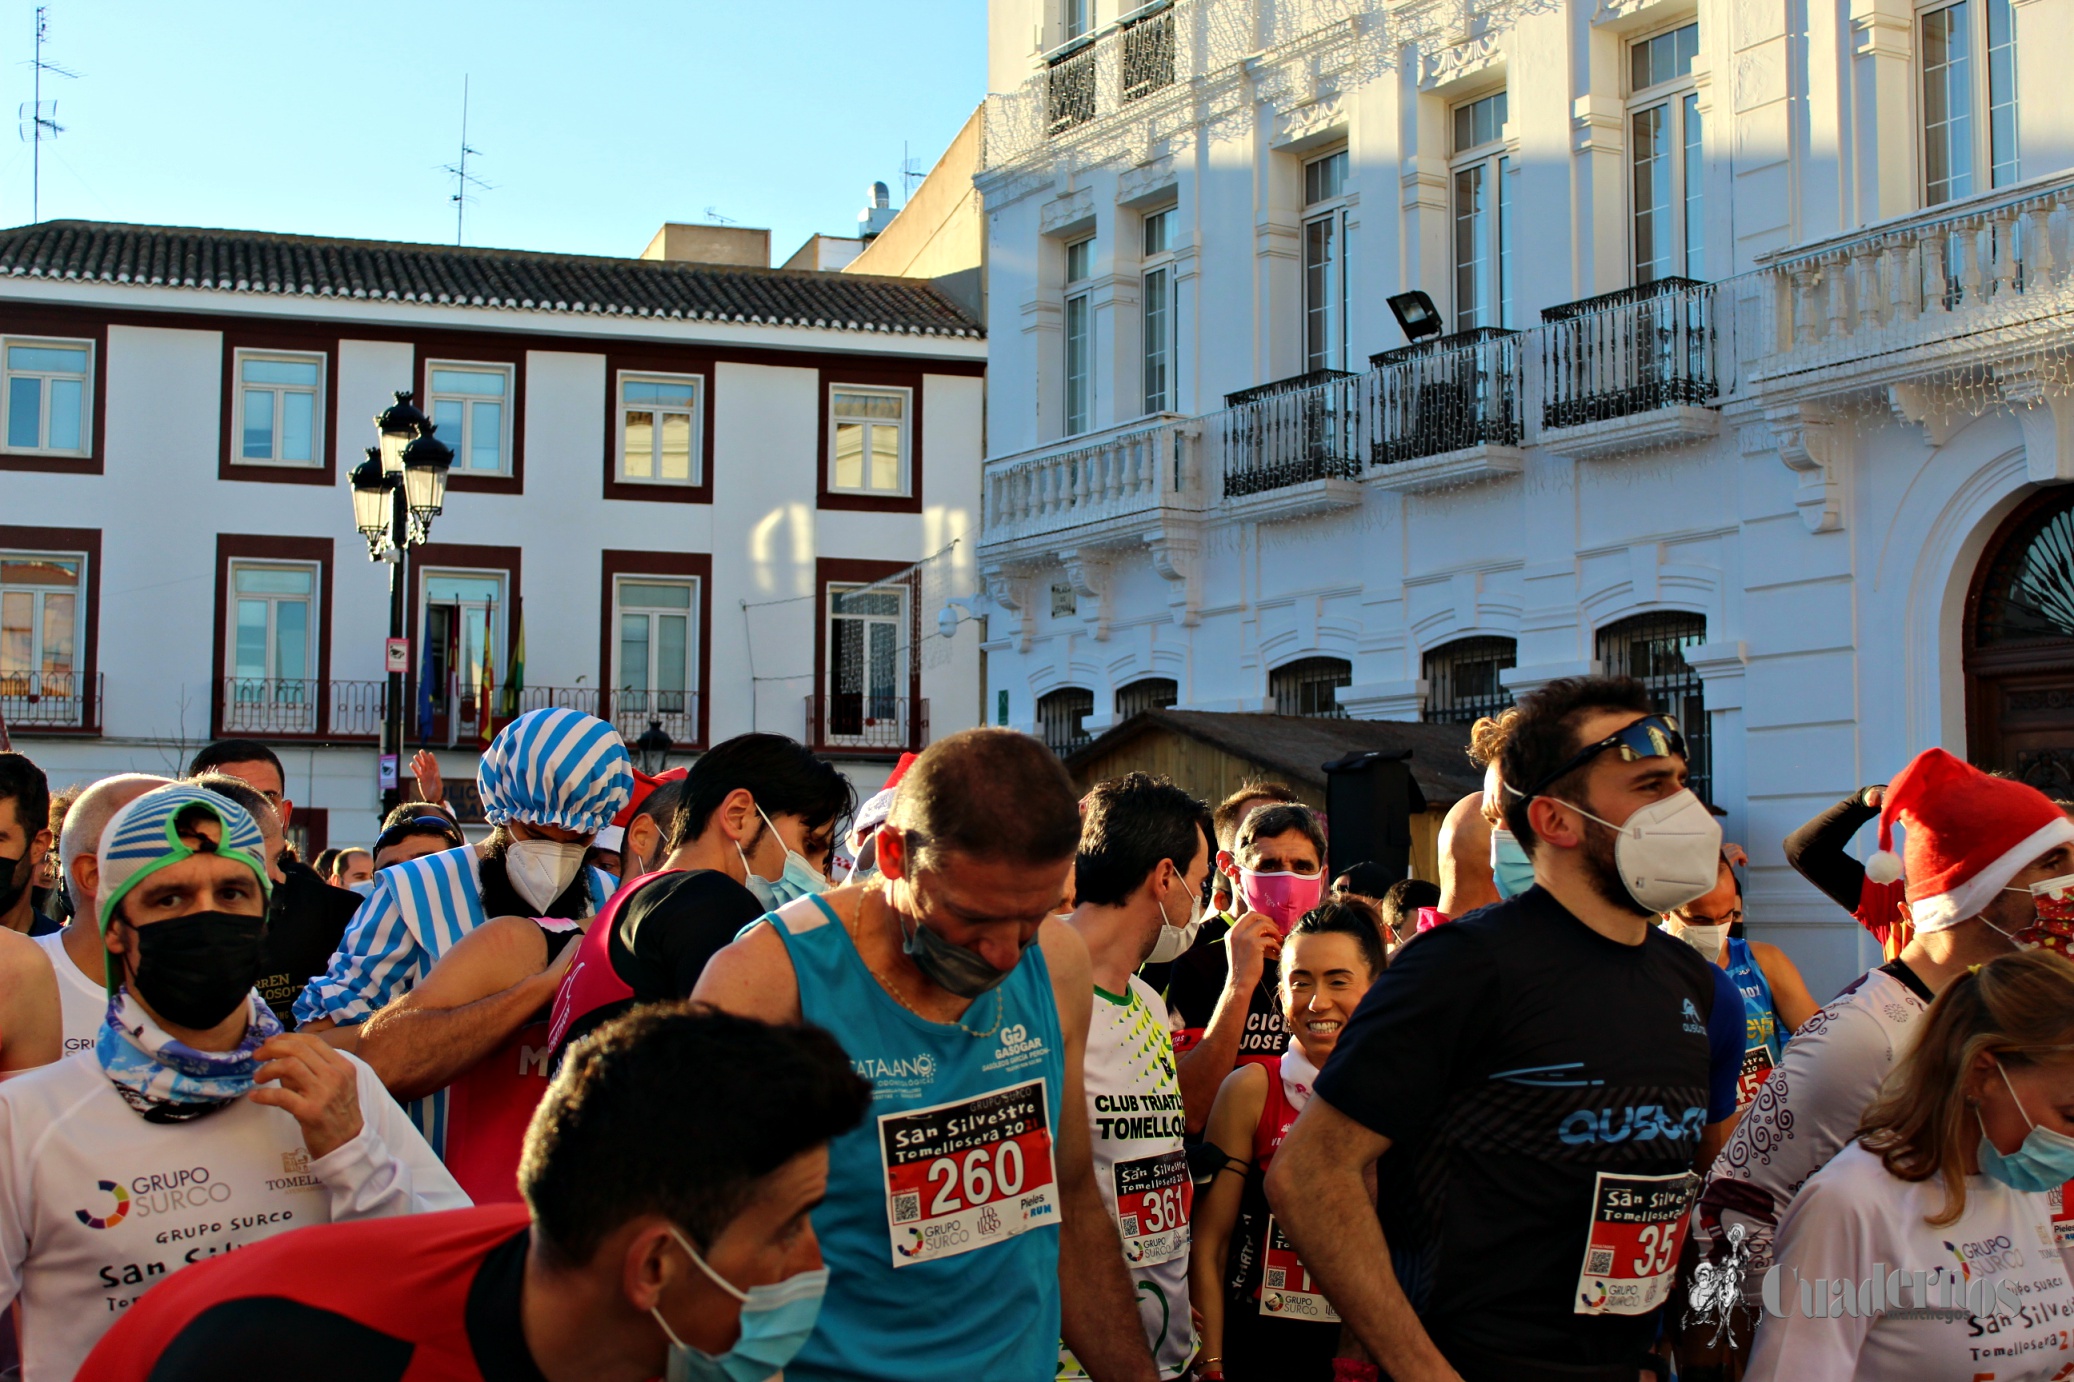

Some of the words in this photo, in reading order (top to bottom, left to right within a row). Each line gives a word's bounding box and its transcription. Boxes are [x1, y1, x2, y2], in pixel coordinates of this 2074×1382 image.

[995, 1037, 1042, 1059] GASOGAR
[970, 1095, 1001, 1112] GRUPO
[1001, 1086, 1032, 1103] SURCO
[1095, 1094, 1139, 1112] CLUB
[895, 1127, 938, 1148] San
[947, 1102, 1035, 1137] Silvestre
[895, 1129, 999, 1163] Tomellosera
[1005, 1117, 1038, 1136] 2021
[132, 1167, 209, 1194] GRUPO
[928, 1140, 1024, 1216] 260
[1122, 1168, 1148, 1183] San
[1153, 1160, 1186, 1177] Silvestre
[1121, 1176, 1177, 1195] Tomellosera
[136, 1182, 231, 1217] SURCO
[1021, 1193, 1044, 1210] Pieles
[1143, 1185, 1187, 1232] 361
[1607, 1191, 1642, 1207] San
[1030, 1204, 1052, 1218] RUN
[1604, 1208, 1681, 1222] Tomellosera
[156, 1222, 222, 1244] GRUPO
[230, 1210, 293, 1231] SURCO
[925, 1219, 961, 1237] GRUPO
[925, 1230, 970, 1250] SURCO
[1144, 1237, 1167, 1249] GRUPO
[1633, 1222, 1677, 1276] 35
[1962, 1235, 2012, 1259] GRUPO
[1145, 1245, 1172, 1259] SURCO
[1970, 1248, 2025, 1277] SURCO
[99, 1261, 166, 1288] San
[1286, 1295, 1312, 1306] GRUPO
[1605, 1295, 1640, 1307] SURCO
[1609, 1284, 1638, 1296] GRUPO
[1284, 1303, 1318, 1316] SURCO
[1968, 1312, 2012, 1337] San
[1969, 1333, 2058, 1361] Tomellosera
